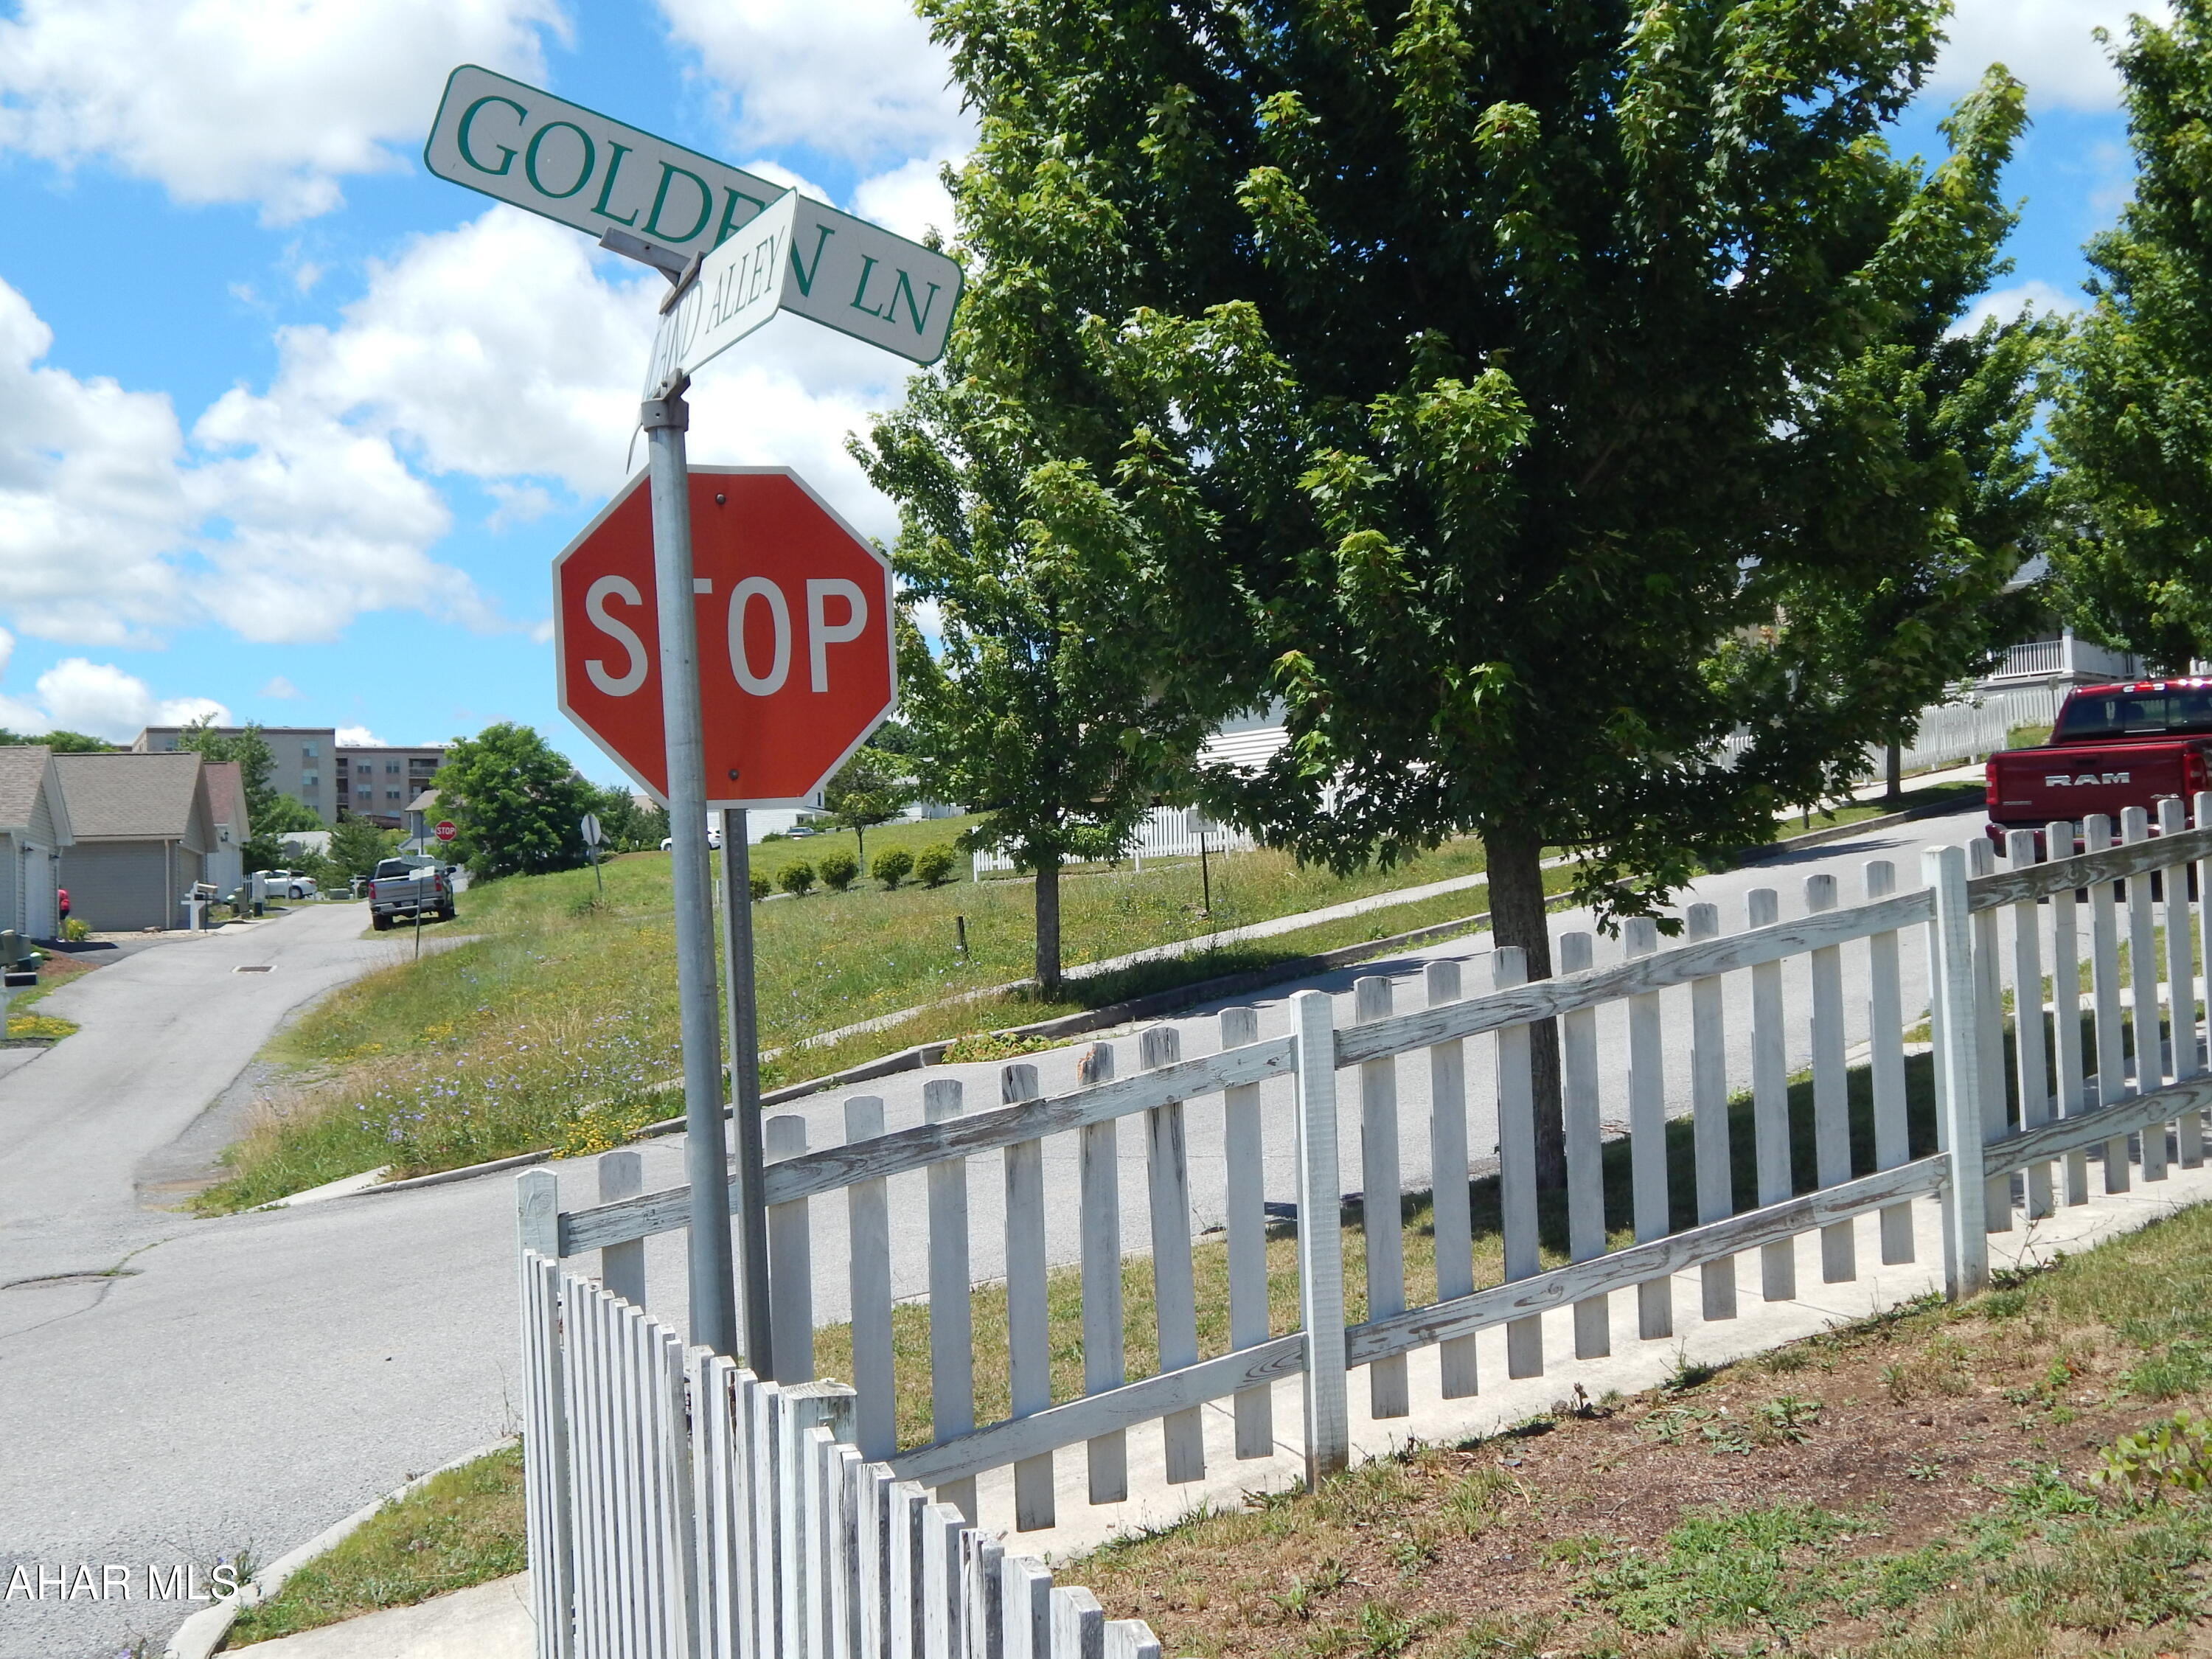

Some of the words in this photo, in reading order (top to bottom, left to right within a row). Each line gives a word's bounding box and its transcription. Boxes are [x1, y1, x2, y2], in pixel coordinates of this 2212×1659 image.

[705, 224, 786, 335] ALLEY
[850, 253, 941, 335] LN
[585, 574, 869, 697] SOP
[2045, 772, 2130, 787] RAM
[437, 827, 456, 835] STOP
